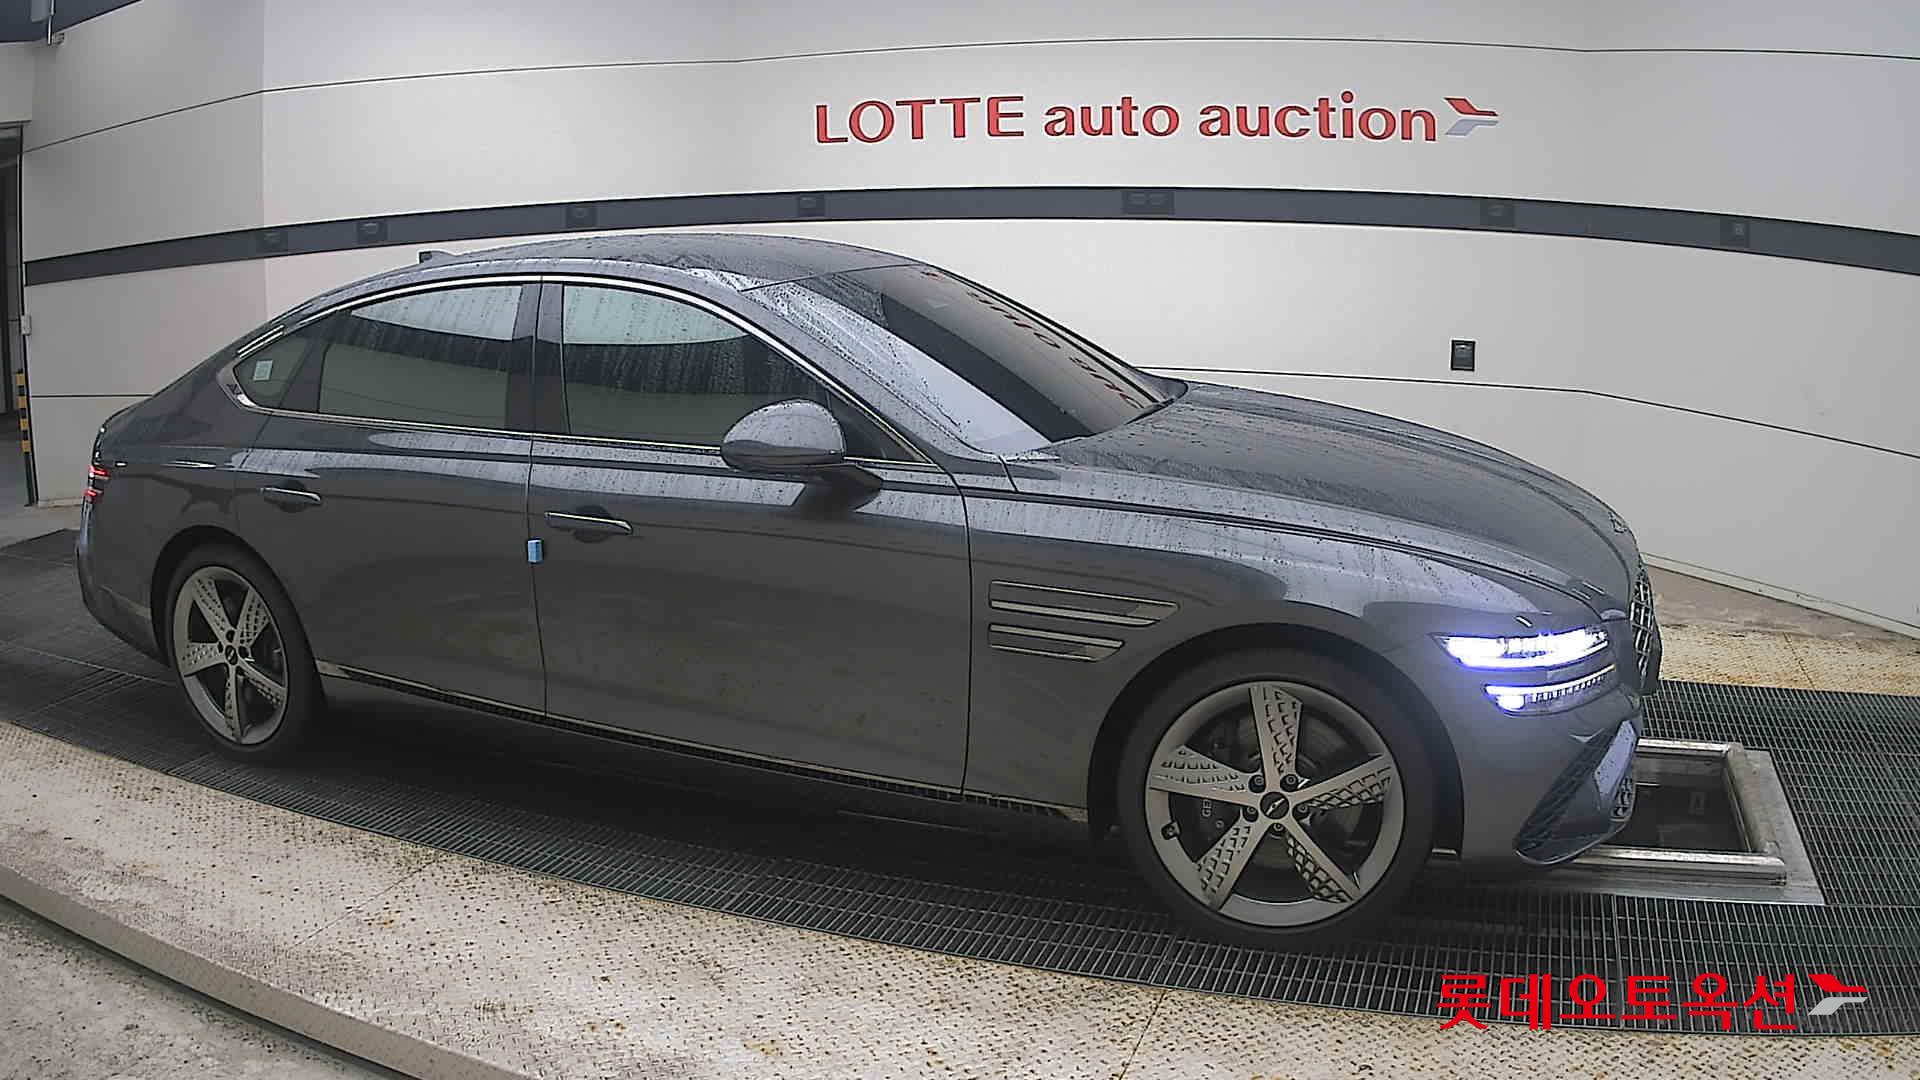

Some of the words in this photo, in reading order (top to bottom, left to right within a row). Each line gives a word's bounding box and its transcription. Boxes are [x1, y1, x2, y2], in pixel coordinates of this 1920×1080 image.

[815, 96, 1025, 144] LOTTE
[1043, 96, 1180, 138] auto
[1199, 90, 1438, 142] auction
